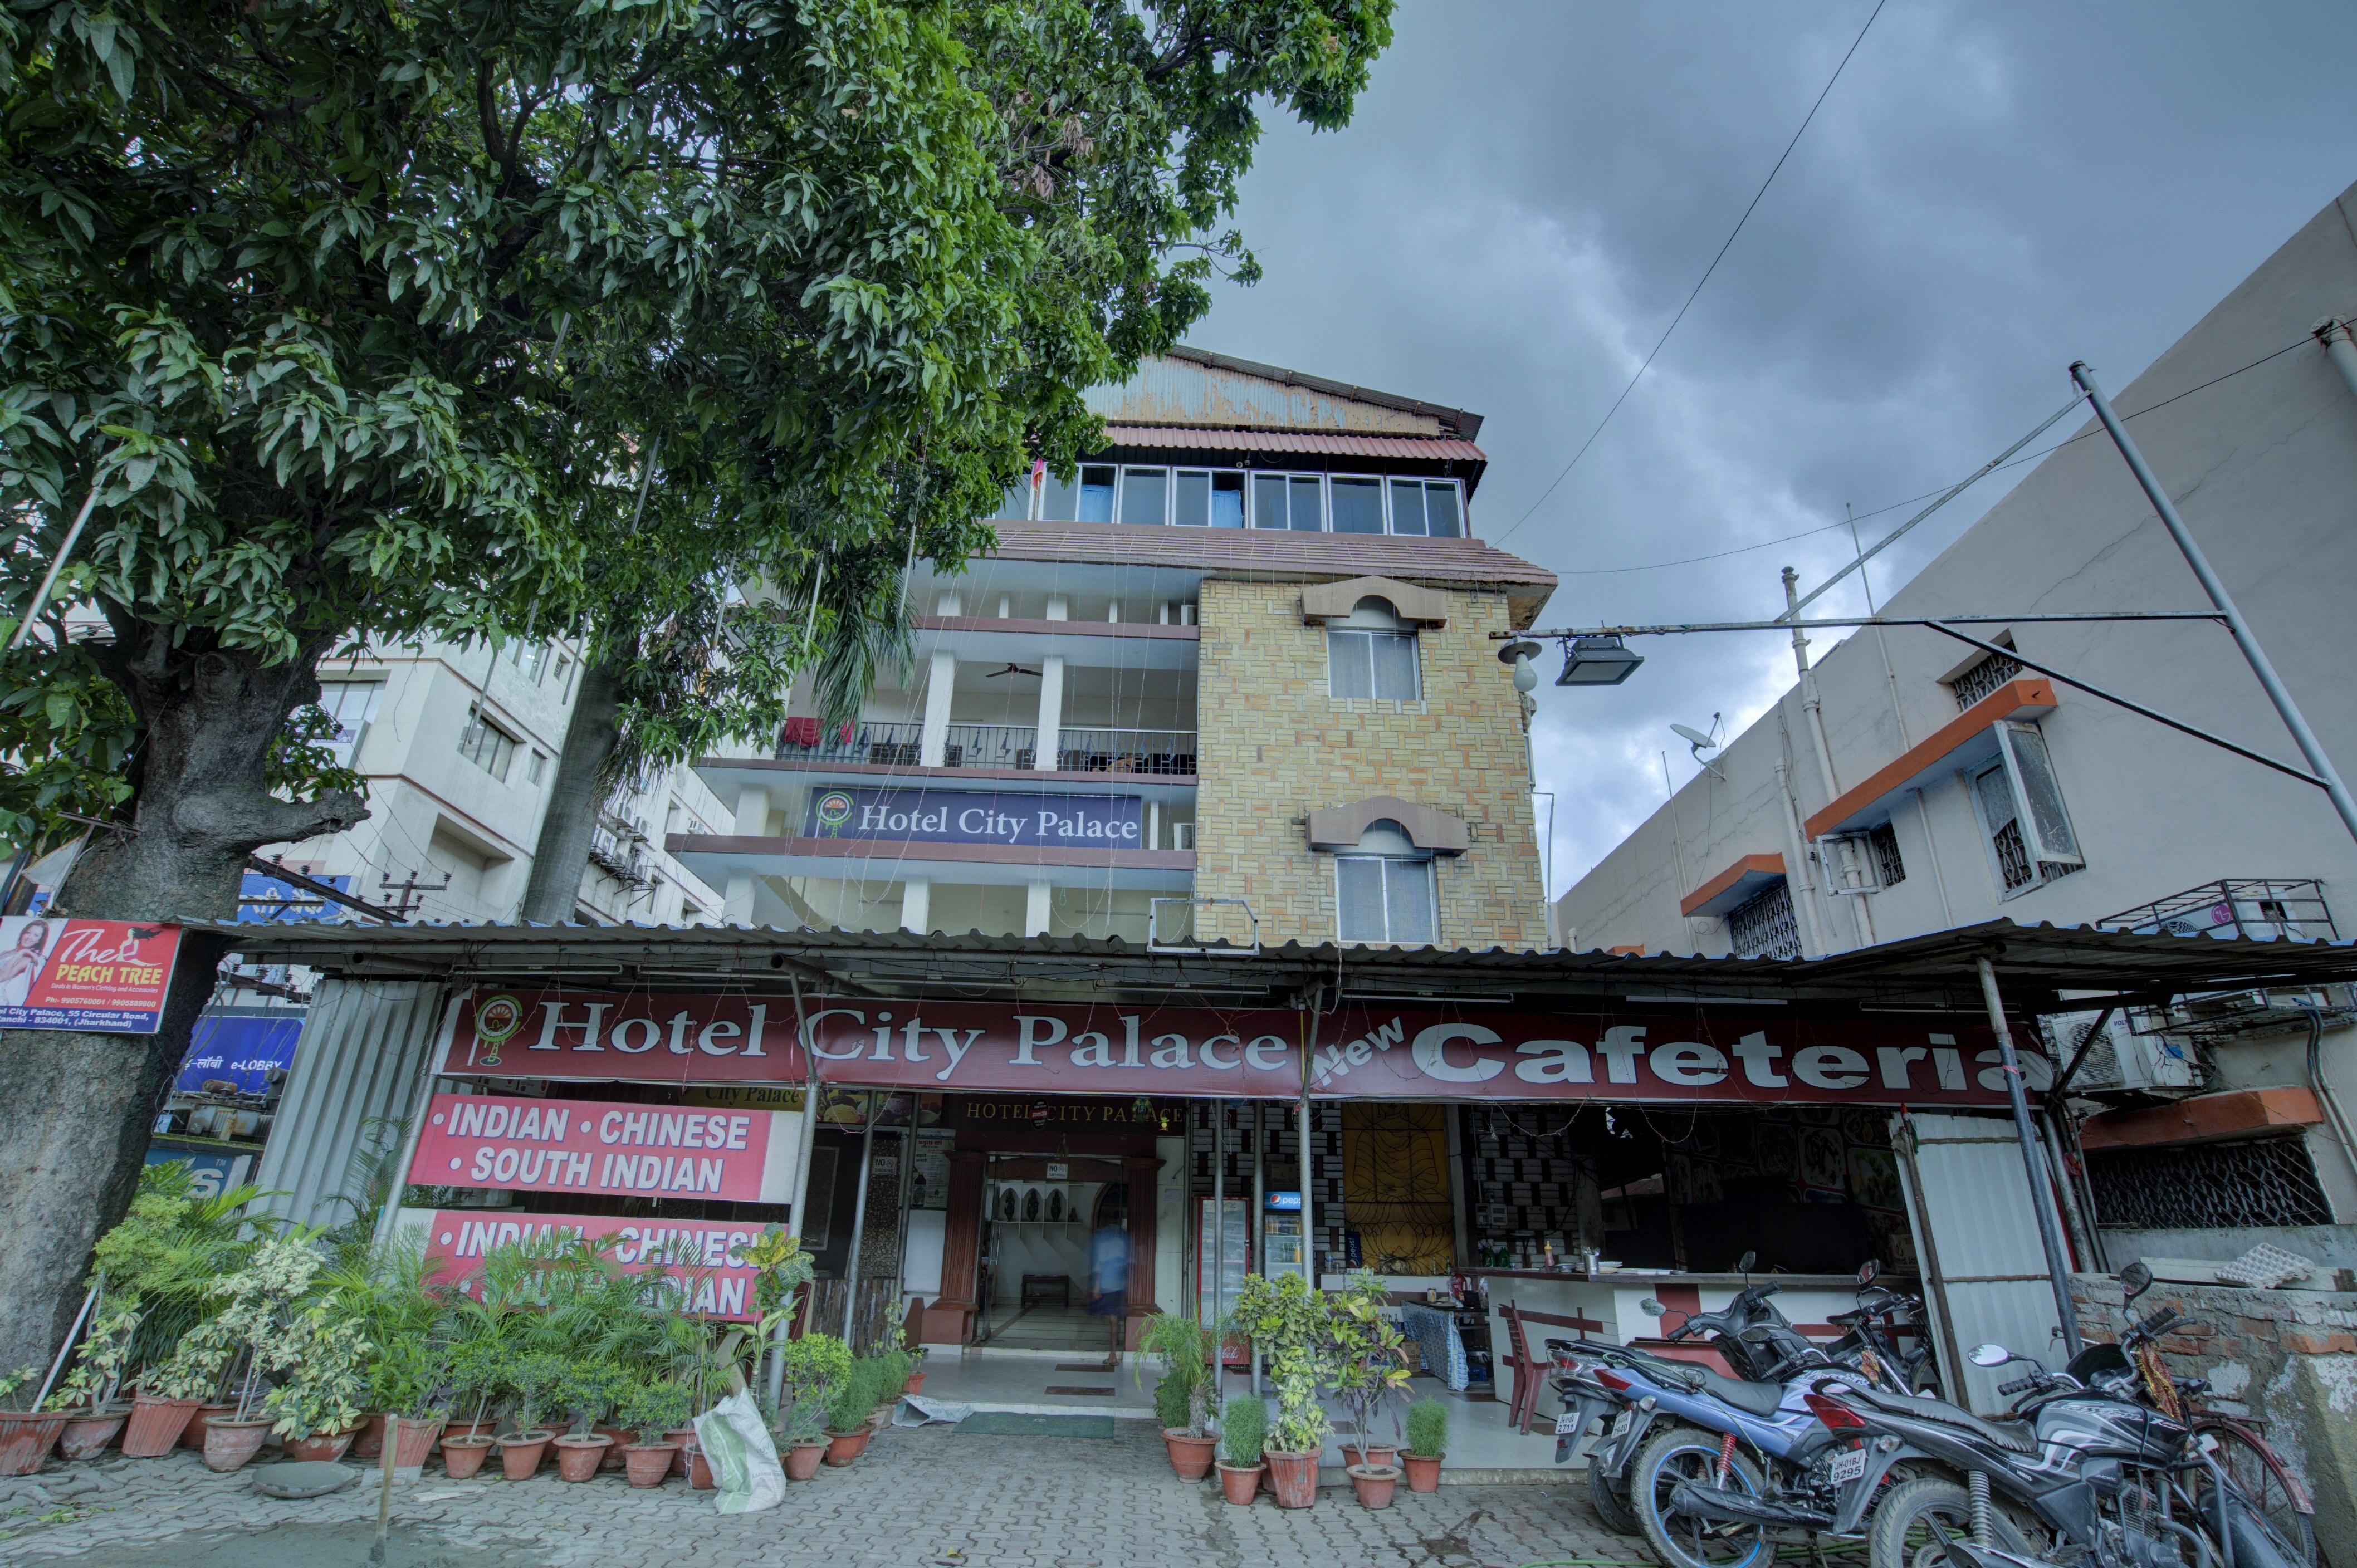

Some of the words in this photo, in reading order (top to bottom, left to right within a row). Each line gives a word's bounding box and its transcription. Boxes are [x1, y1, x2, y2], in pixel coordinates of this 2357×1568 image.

[859, 805, 947, 832] Hotel
[959, 808, 1028, 843] City
[1036, 811, 1137, 839] Palace
[60, 929, 119, 964] The
[56, 964, 115, 984] PEACH
[119, 967, 163, 986] TREE
[95, 984, 116, 993] Clothing
[9, 1008, 29, 1016] City
[30, 1008, 66, 1018] Palace,
[82, 1011, 121, 1019] Circular
[121, 1012, 150, 1021] Road,
[34, 1017, 72, 1026] 834001,
[74, 1018, 133, 1028] (Jharkhand)
[527, 1001, 769, 1058] Hotel
[796, 1008, 987, 1081] City
[1008, 1015, 1288, 1071] Palace
[1312, 1016, 1406, 1087] New
[1410, 1022, 2055, 1092] Cafeteria
[231, 1059, 283, 1071] e-LOBBY
[705, 1086, 741, 1105] City
[745, 1087, 799, 1104] Palace
[1102, 1106, 1183, 1123] PAACE
[447, 1102, 570, 1143] INDIAN
[598, 1110, 751, 1150] CHINESE
[216, 1159, 227, 1167] TM
[471, 1145, 599, 1187] SOUTH
[599, 1154, 725, 1193] INDIAN
[455, 1221, 584, 1262] INDIAN
[1348, 1237, 1358, 1258] pepsi
[1557, 1424, 1574, 1433] 2711
[1833, 1465, 1861, 1481] 9295
